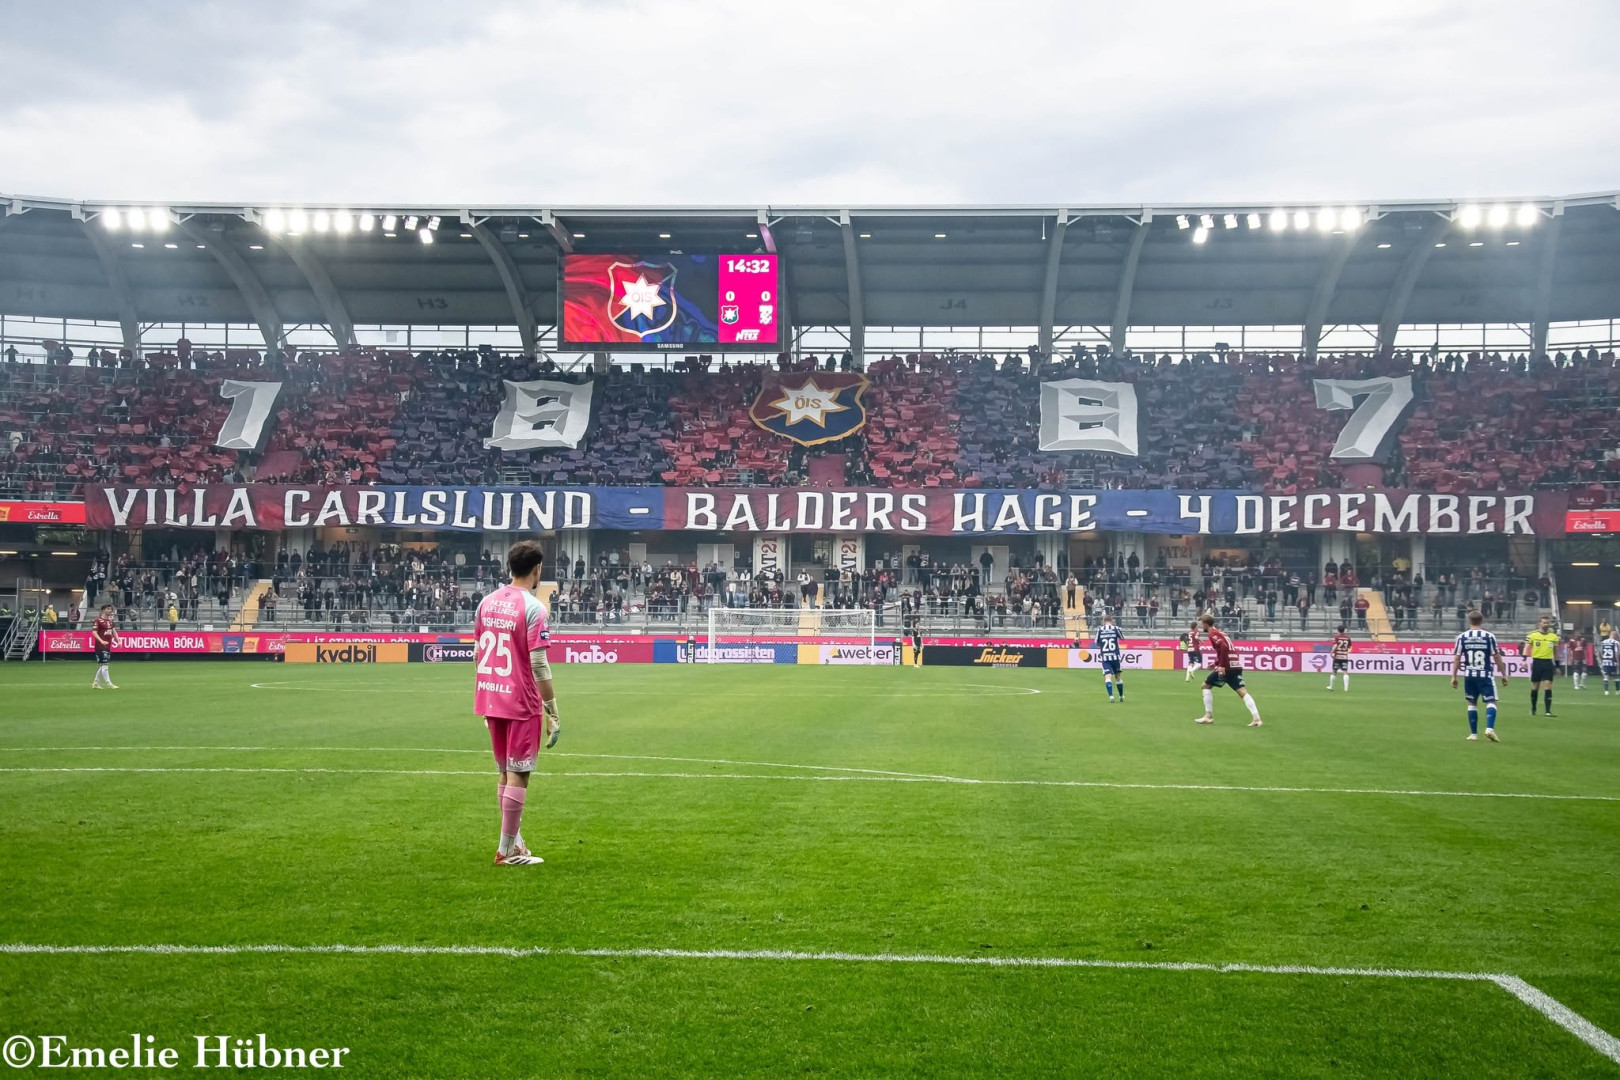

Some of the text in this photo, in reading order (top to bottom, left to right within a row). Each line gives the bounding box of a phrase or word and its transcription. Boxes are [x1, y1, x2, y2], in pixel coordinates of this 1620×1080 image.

[727, 259, 770, 274] 14:32
[631, 290, 653, 303] ÖIS
[725, 291, 771, 302] 0 0
[417, 298, 448, 310] H3
[939, 298, 968, 311] J4
[794, 395, 822, 410] ÖIS
[215, 375, 1414, 458] 1 8 8 7
[28, 510, 59, 520] Estrella
[103, 487, 256, 527] VILLA
[284, 489, 592, 530] CARLSLUND
[685, 492, 928, 532] BALDERS
[951, 492, 1098, 532] HAGE
[1178, 494, 1211, 534] 4
[1235, 493, 1537, 536] DECEMBER
[1573, 520, 1606, 530] Estrella
[51, 640, 81, 649] Estrella
[112, 636, 169, 649] STUNDERNA
[173, 634, 205, 649] BÖRJA
[1101, 638, 1116, 652] 26
[1337, 640, 1349, 651] 23
[316, 644, 376, 663] kvdbil
[477, 630, 513, 677] 25
[566, 645, 618, 663] habo
[842, 646, 892, 659] weber
[974, 648, 1024, 663] Snickers
[1467, 650, 1486, 668] 18
[1603, 648, 1614, 659] 29
[478, 681, 512, 694] MOBILL
